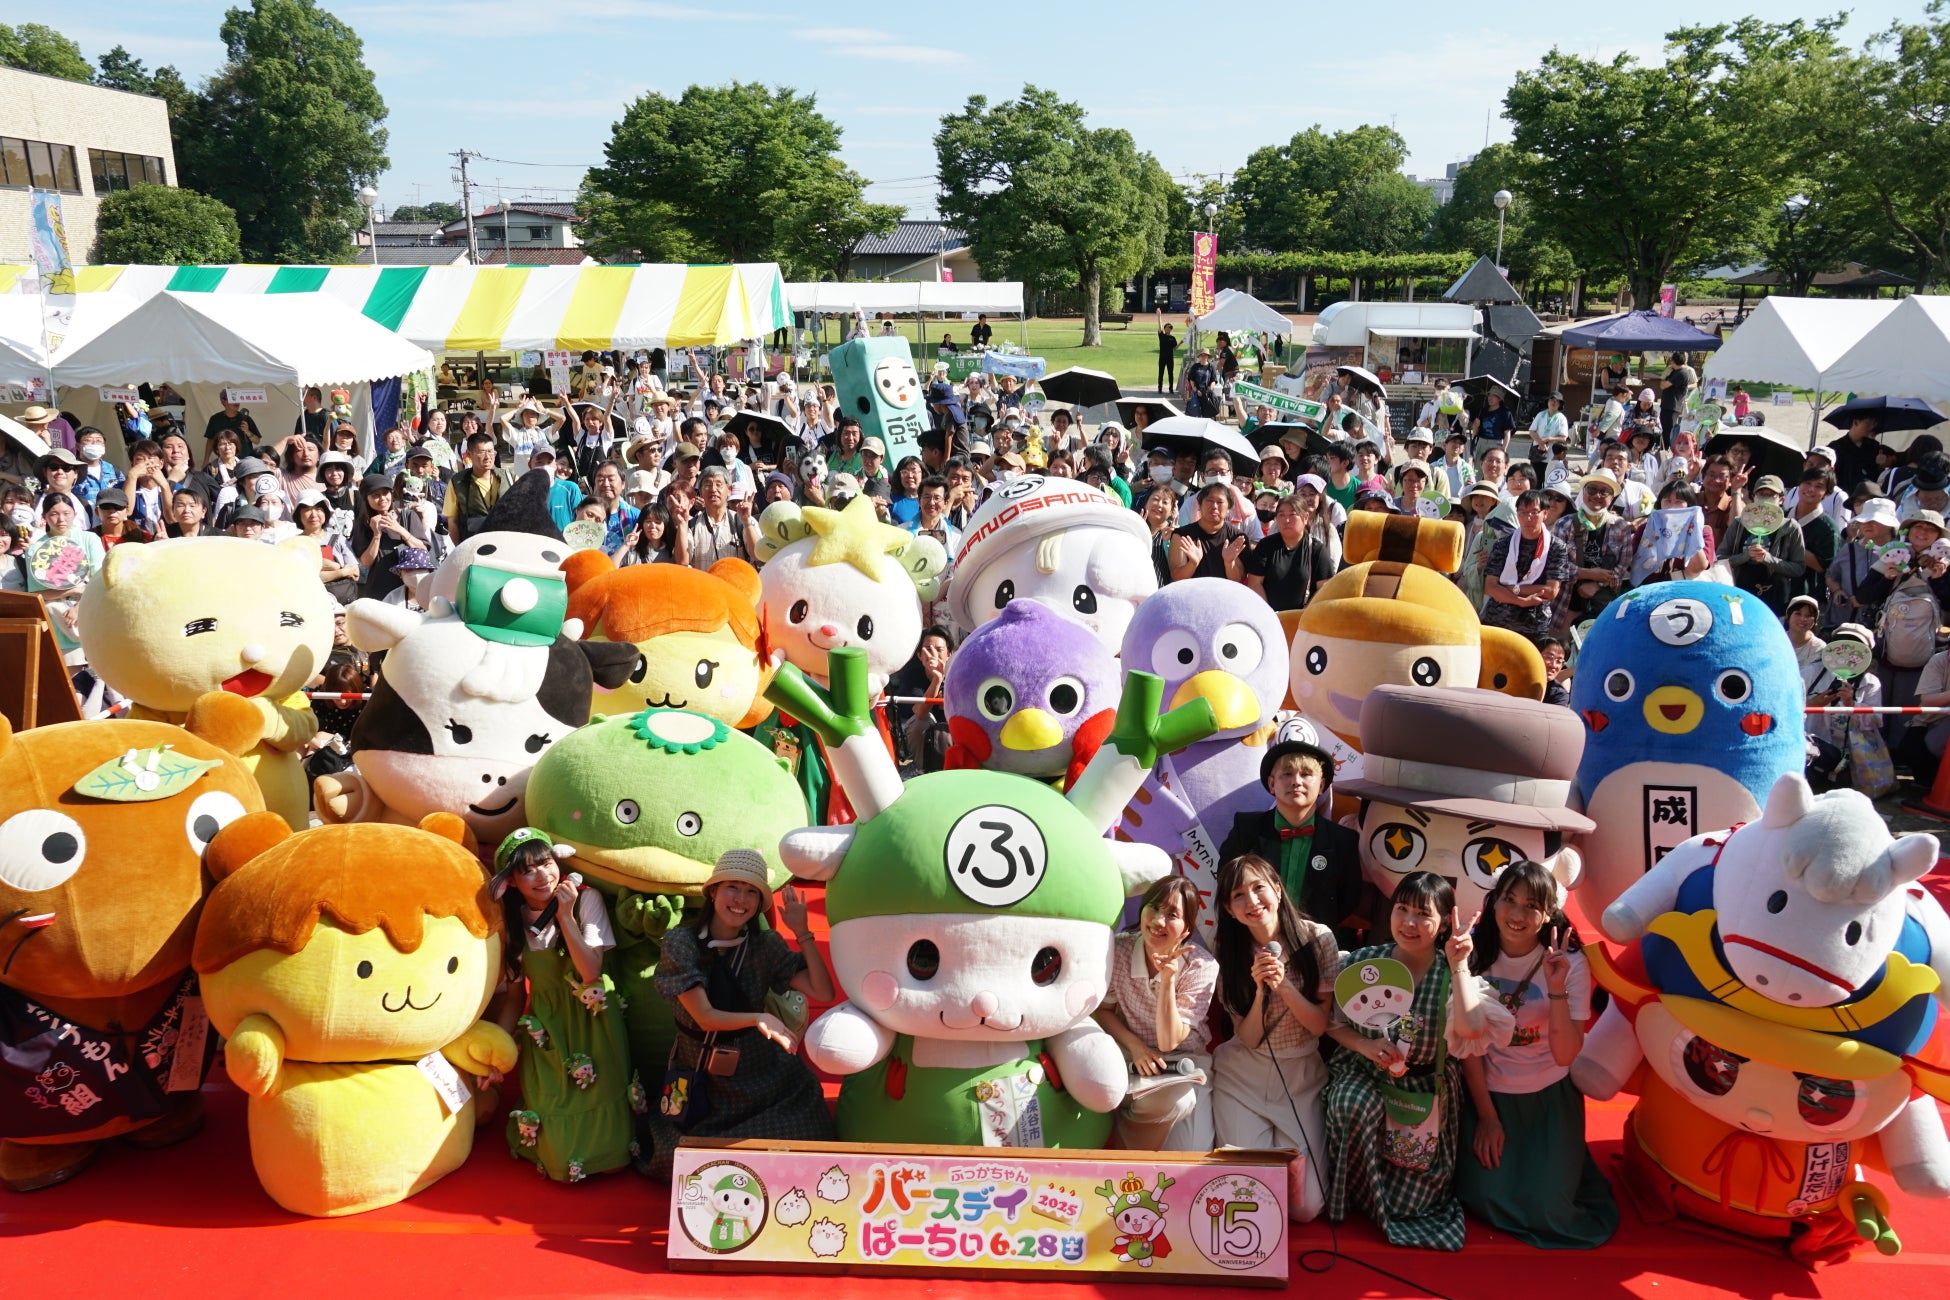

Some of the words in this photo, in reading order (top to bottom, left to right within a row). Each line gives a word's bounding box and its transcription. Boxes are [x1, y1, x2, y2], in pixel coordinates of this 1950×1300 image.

[1666, 604, 1695, 639] う
[957, 820, 1035, 889] ふ
[1025, 1098, 1041, 1140] 深谷市
[951, 1166, 1029, 1184] ふっかちゃん
[862, 1167, 1029, 1222] バースデイ
[1037, 1194, 1079, 1217] 2025
[989, 1232, 1058, 1259] 6.28
[1217, 1258, 1257, 1266] ANNIVERSARY
